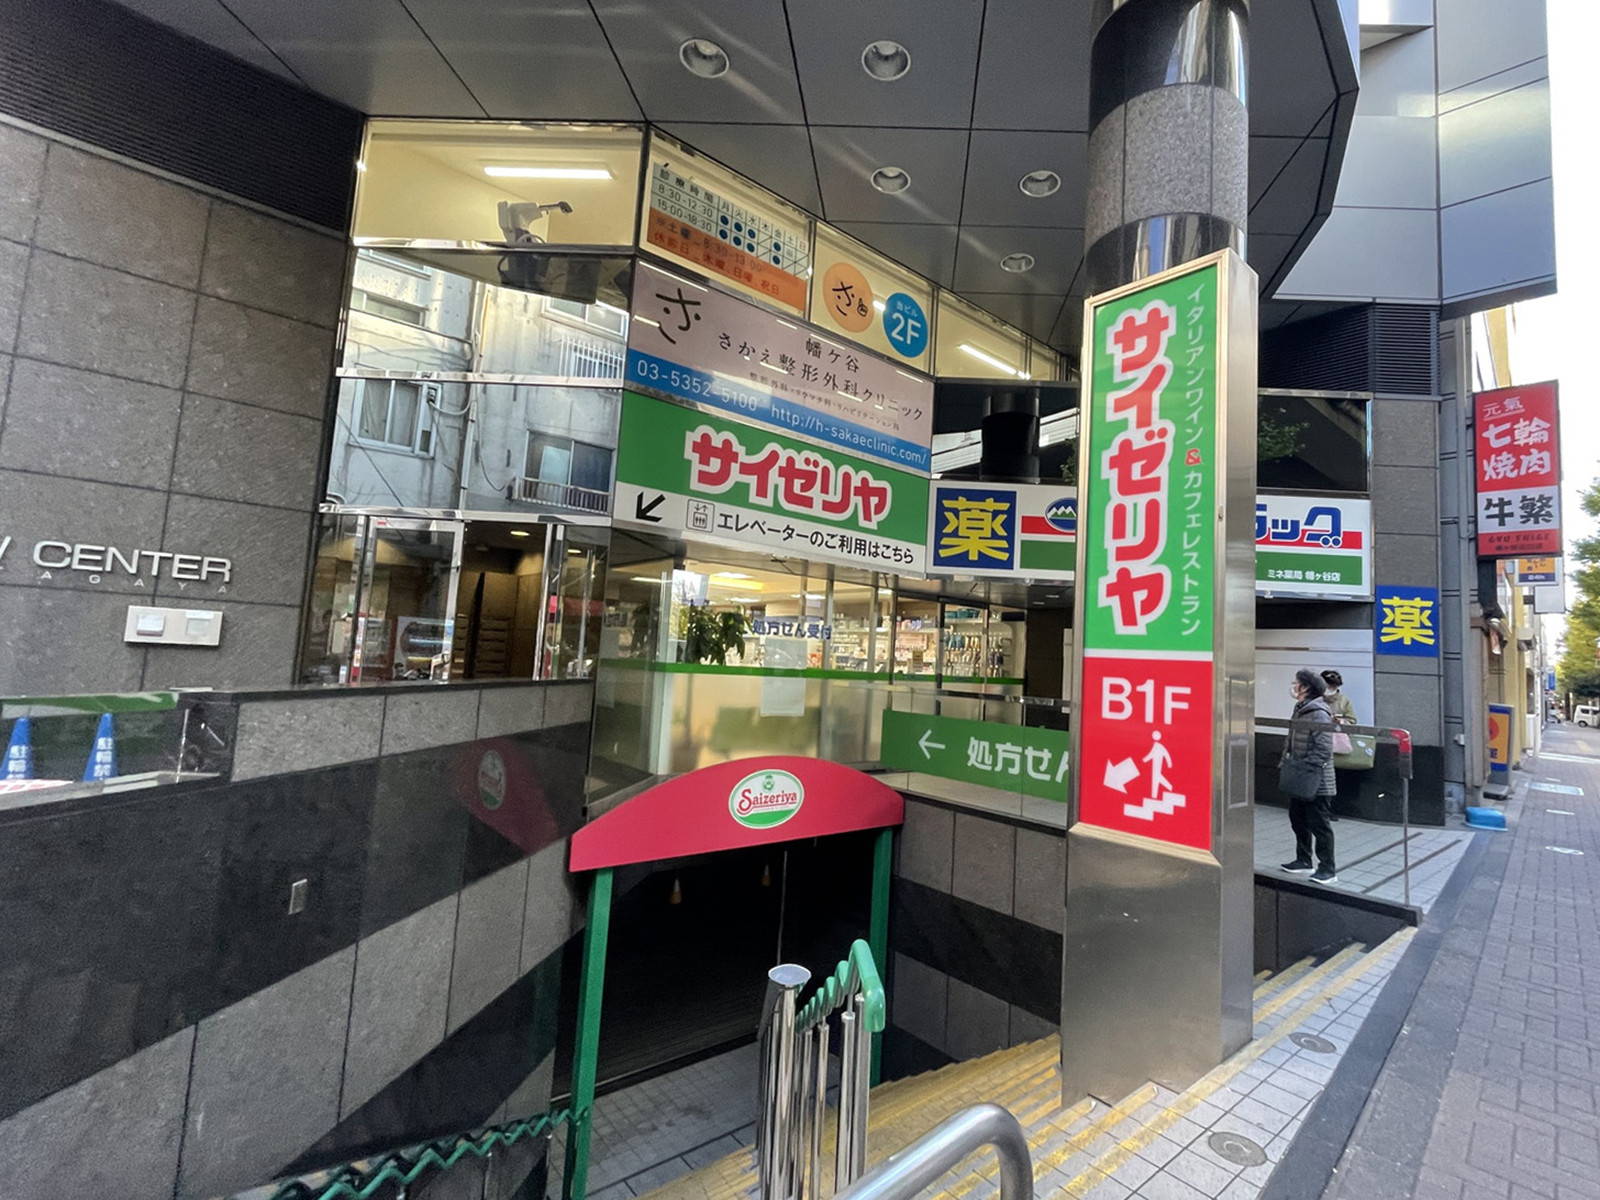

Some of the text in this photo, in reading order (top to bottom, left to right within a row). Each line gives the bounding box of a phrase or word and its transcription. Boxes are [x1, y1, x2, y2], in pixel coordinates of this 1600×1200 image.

[891, 312, 922, 345] 2F
[718, 332, 924, 421] さかえ整形外科クリニック
[636, 359, 928, 465] 03-5352-5100 http://h-sakaeclinic.com/
[1481, 416, 1551, 449] 七輪
[688, 427, 892, 528] サイゼリヤ
[1100, 302, 1174, 632] サイゼリヤ
[1482, 448, 1552, 482] 焼肉
[938, 496, 1011, 562] 薬
[1483, 494, 1554, 527] 牛繁
[33, 539, 233, 583] CENTER
[716, 511, 915, 565] エレベーターのご利用はこちら
[752, 618, 832, 640] 処方せん受付
[1380, 596, 1436, 646] 薬
[1101, 676, 1192, 726] B1F
[737, 787, 798, 813] Saizeriya
